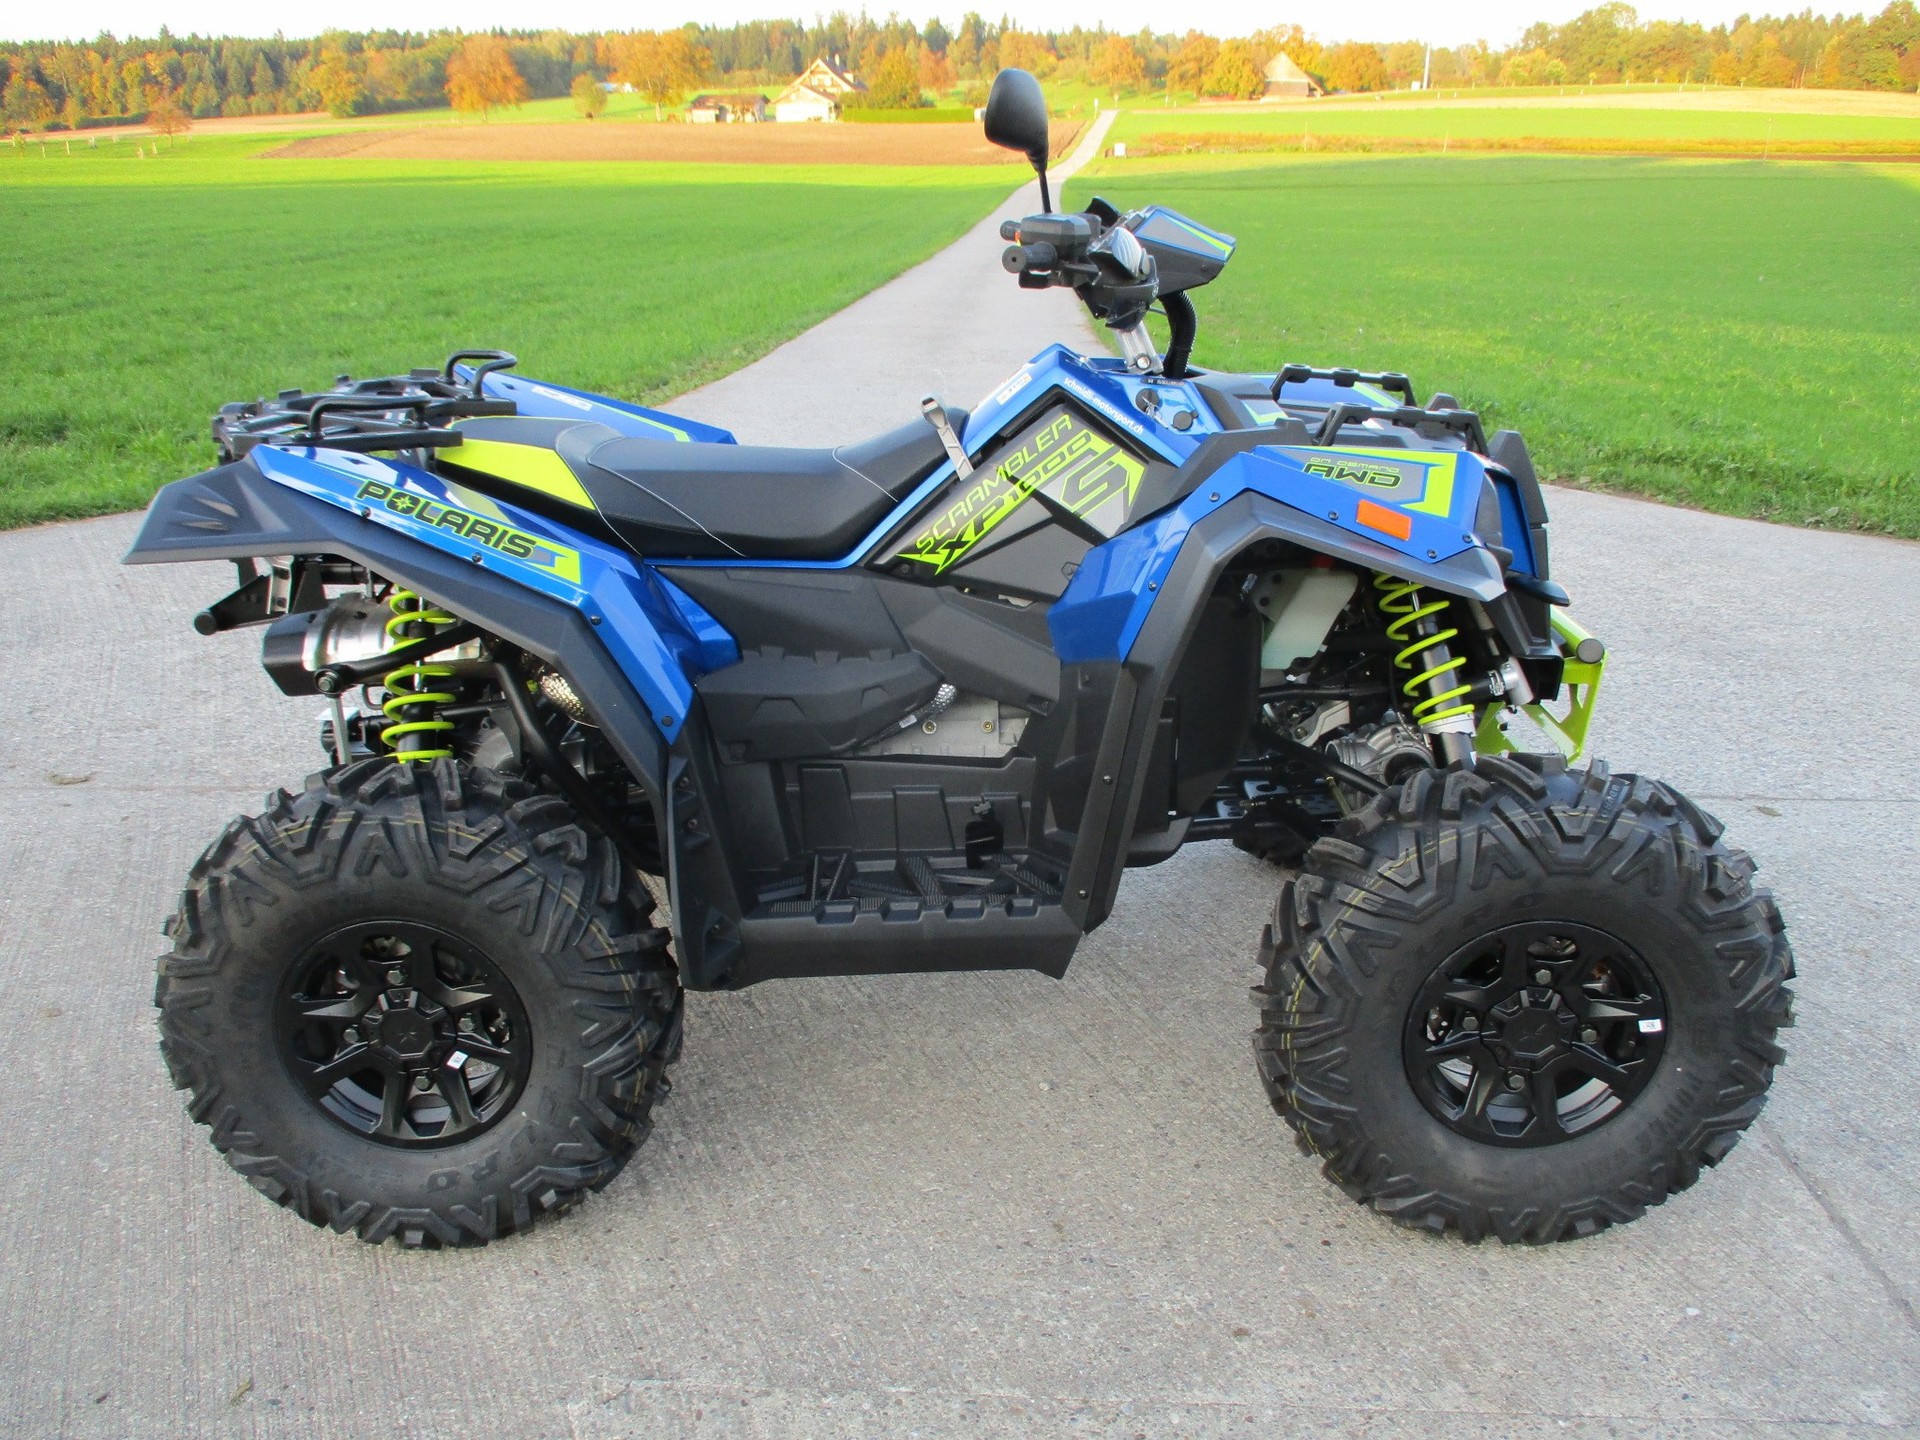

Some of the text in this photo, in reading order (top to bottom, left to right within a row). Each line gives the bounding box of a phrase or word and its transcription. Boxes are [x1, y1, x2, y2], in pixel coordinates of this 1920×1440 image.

[1063, 377, 1144, 434] schmidli-motorsport.ch
[916, 414, 1073, 557] SCRAMBLER
[1302, 462, 1403, 489] AWD
[356, 479, 538, 560] POLARIS
